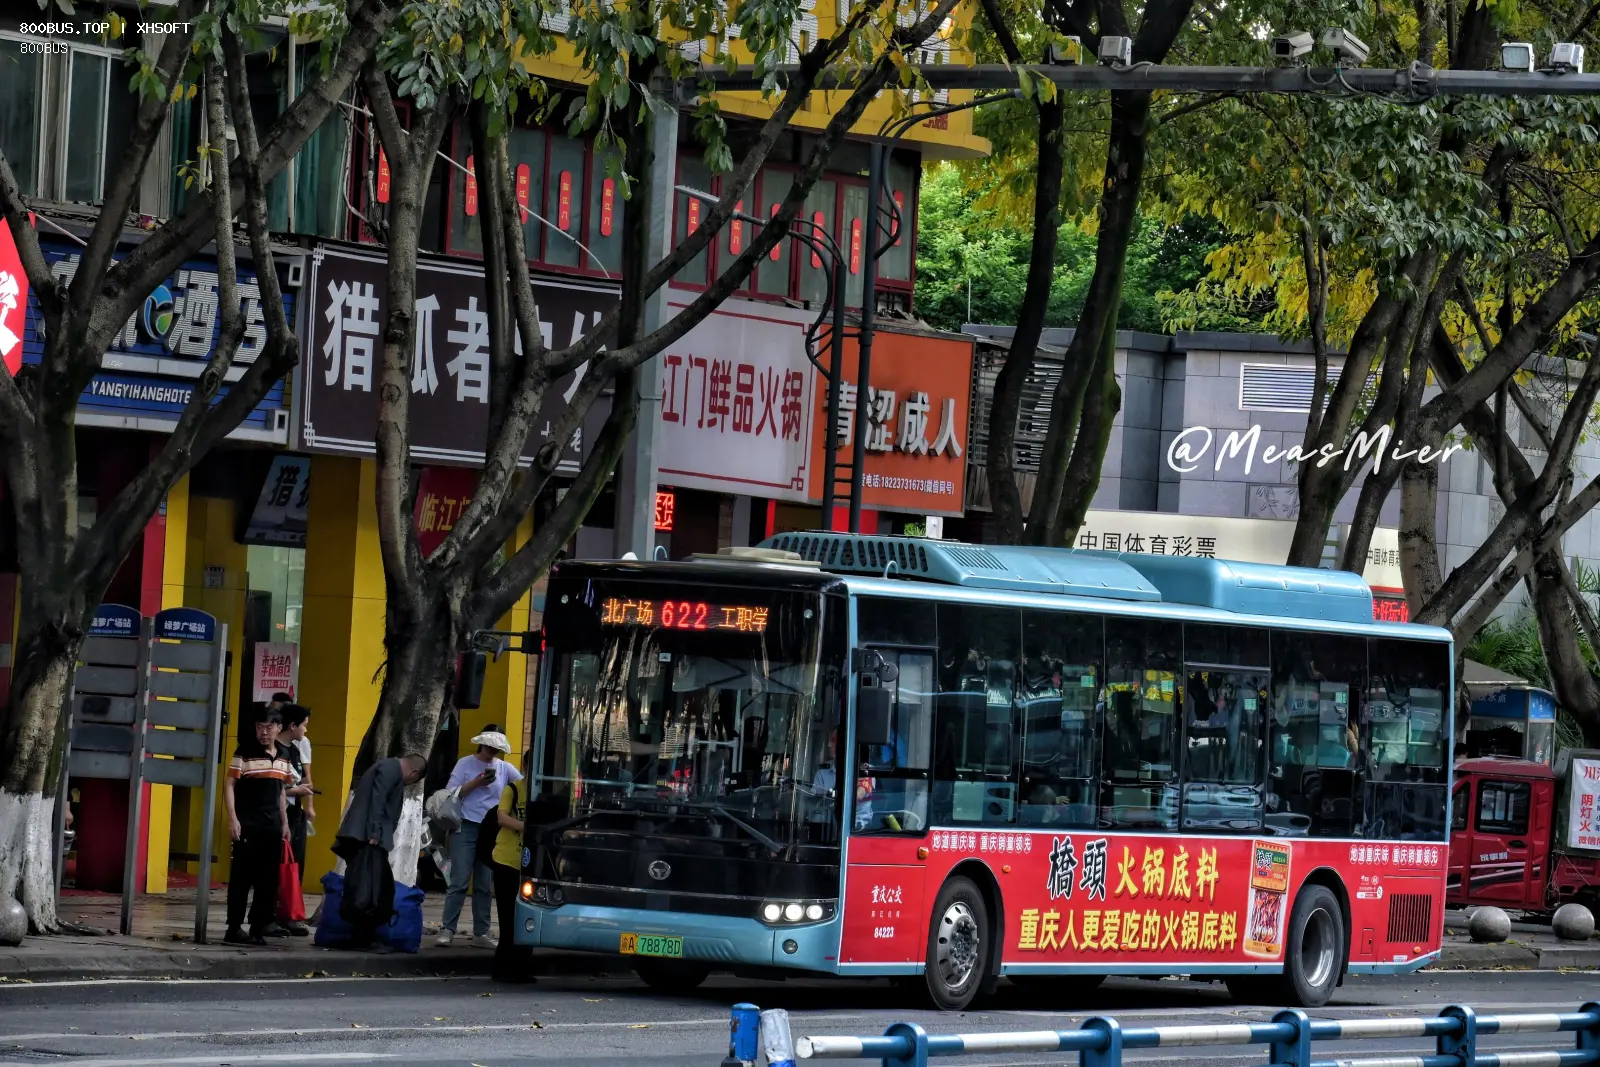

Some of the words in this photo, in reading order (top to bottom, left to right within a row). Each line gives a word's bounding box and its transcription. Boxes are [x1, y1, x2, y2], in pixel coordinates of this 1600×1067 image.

[1079, 530, 1217, 558] 中国体育彩票
[601, 598, 653, 625] 北广场
[661, 601, 707, 629] 622
[718, 606, 769, 632] 工职学
[1114, 844, 1219, 901] 火锅底料
[874, 926, 894, 938] 84223
[1018, 908, 1238, 951] 重庆人更爱吃的火锅底料
